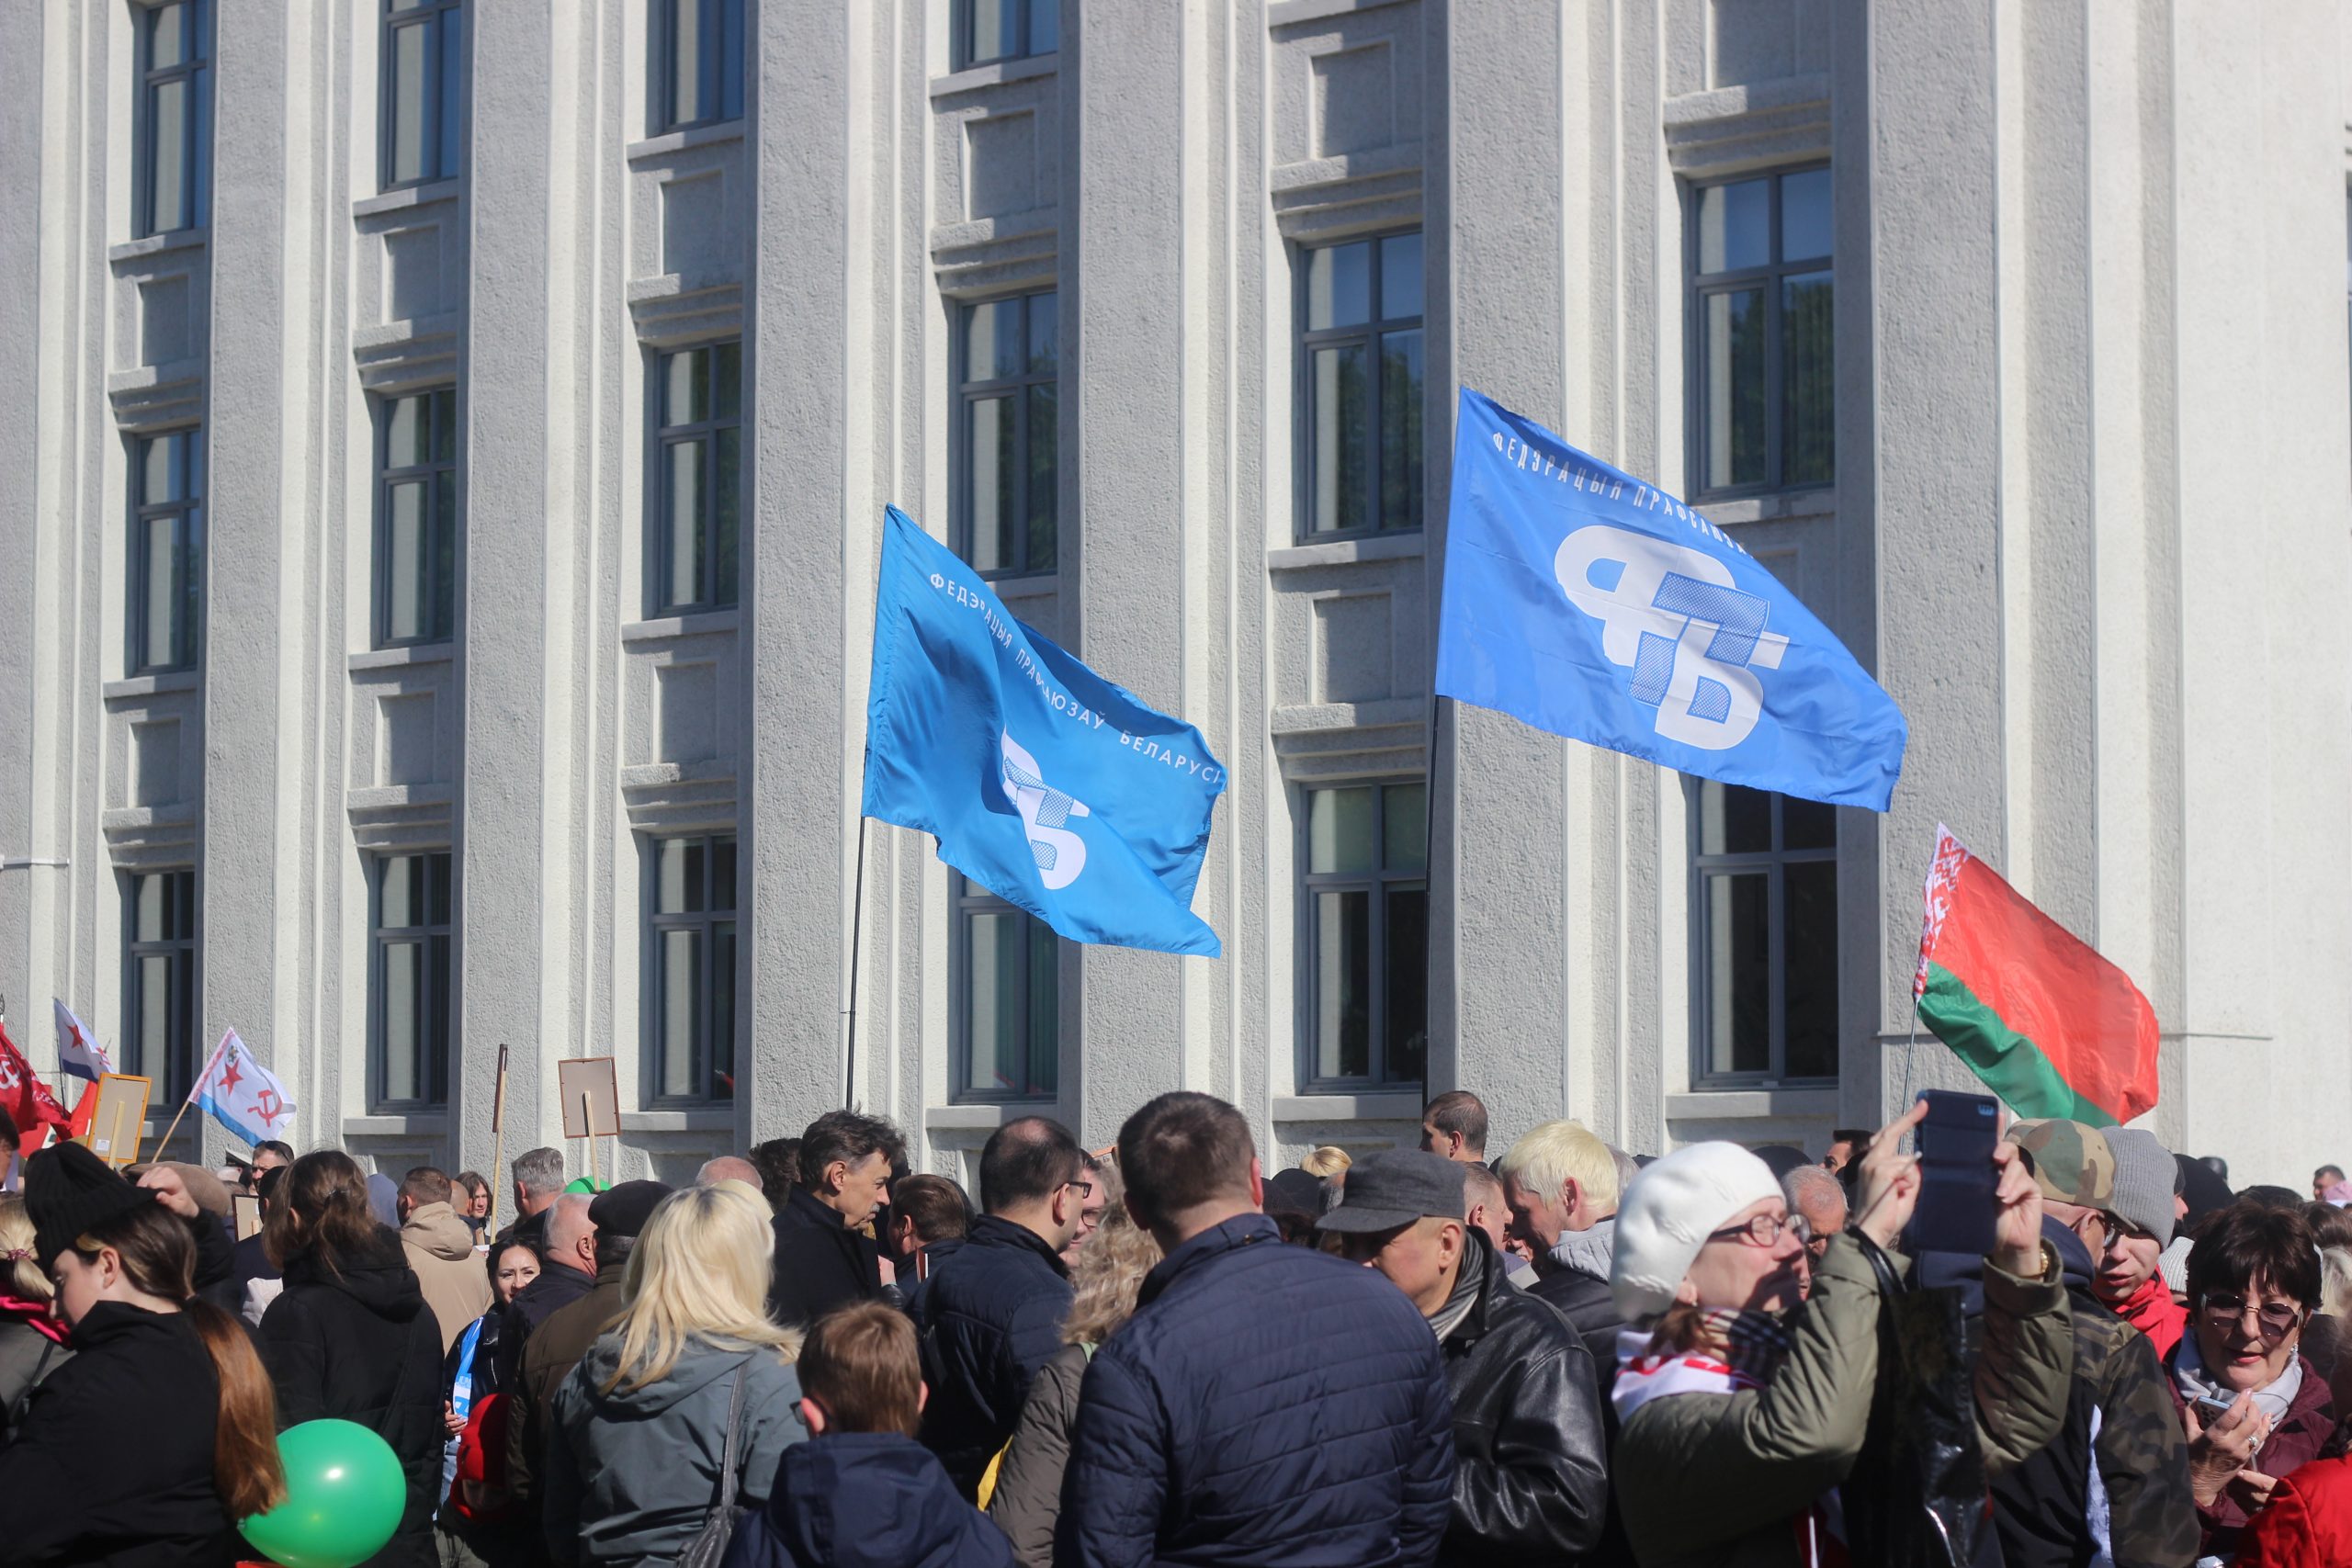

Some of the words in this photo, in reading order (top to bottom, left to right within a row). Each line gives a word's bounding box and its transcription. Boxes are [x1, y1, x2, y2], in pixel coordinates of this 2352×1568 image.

[1492, 431, 1624, 501] ФЕДЭРАЦЫЯ
[1634, 485, 1754, 558] ПРАФСАЮЗА
[1119, 729, 1221, 784] БЕЛАРУСІ
